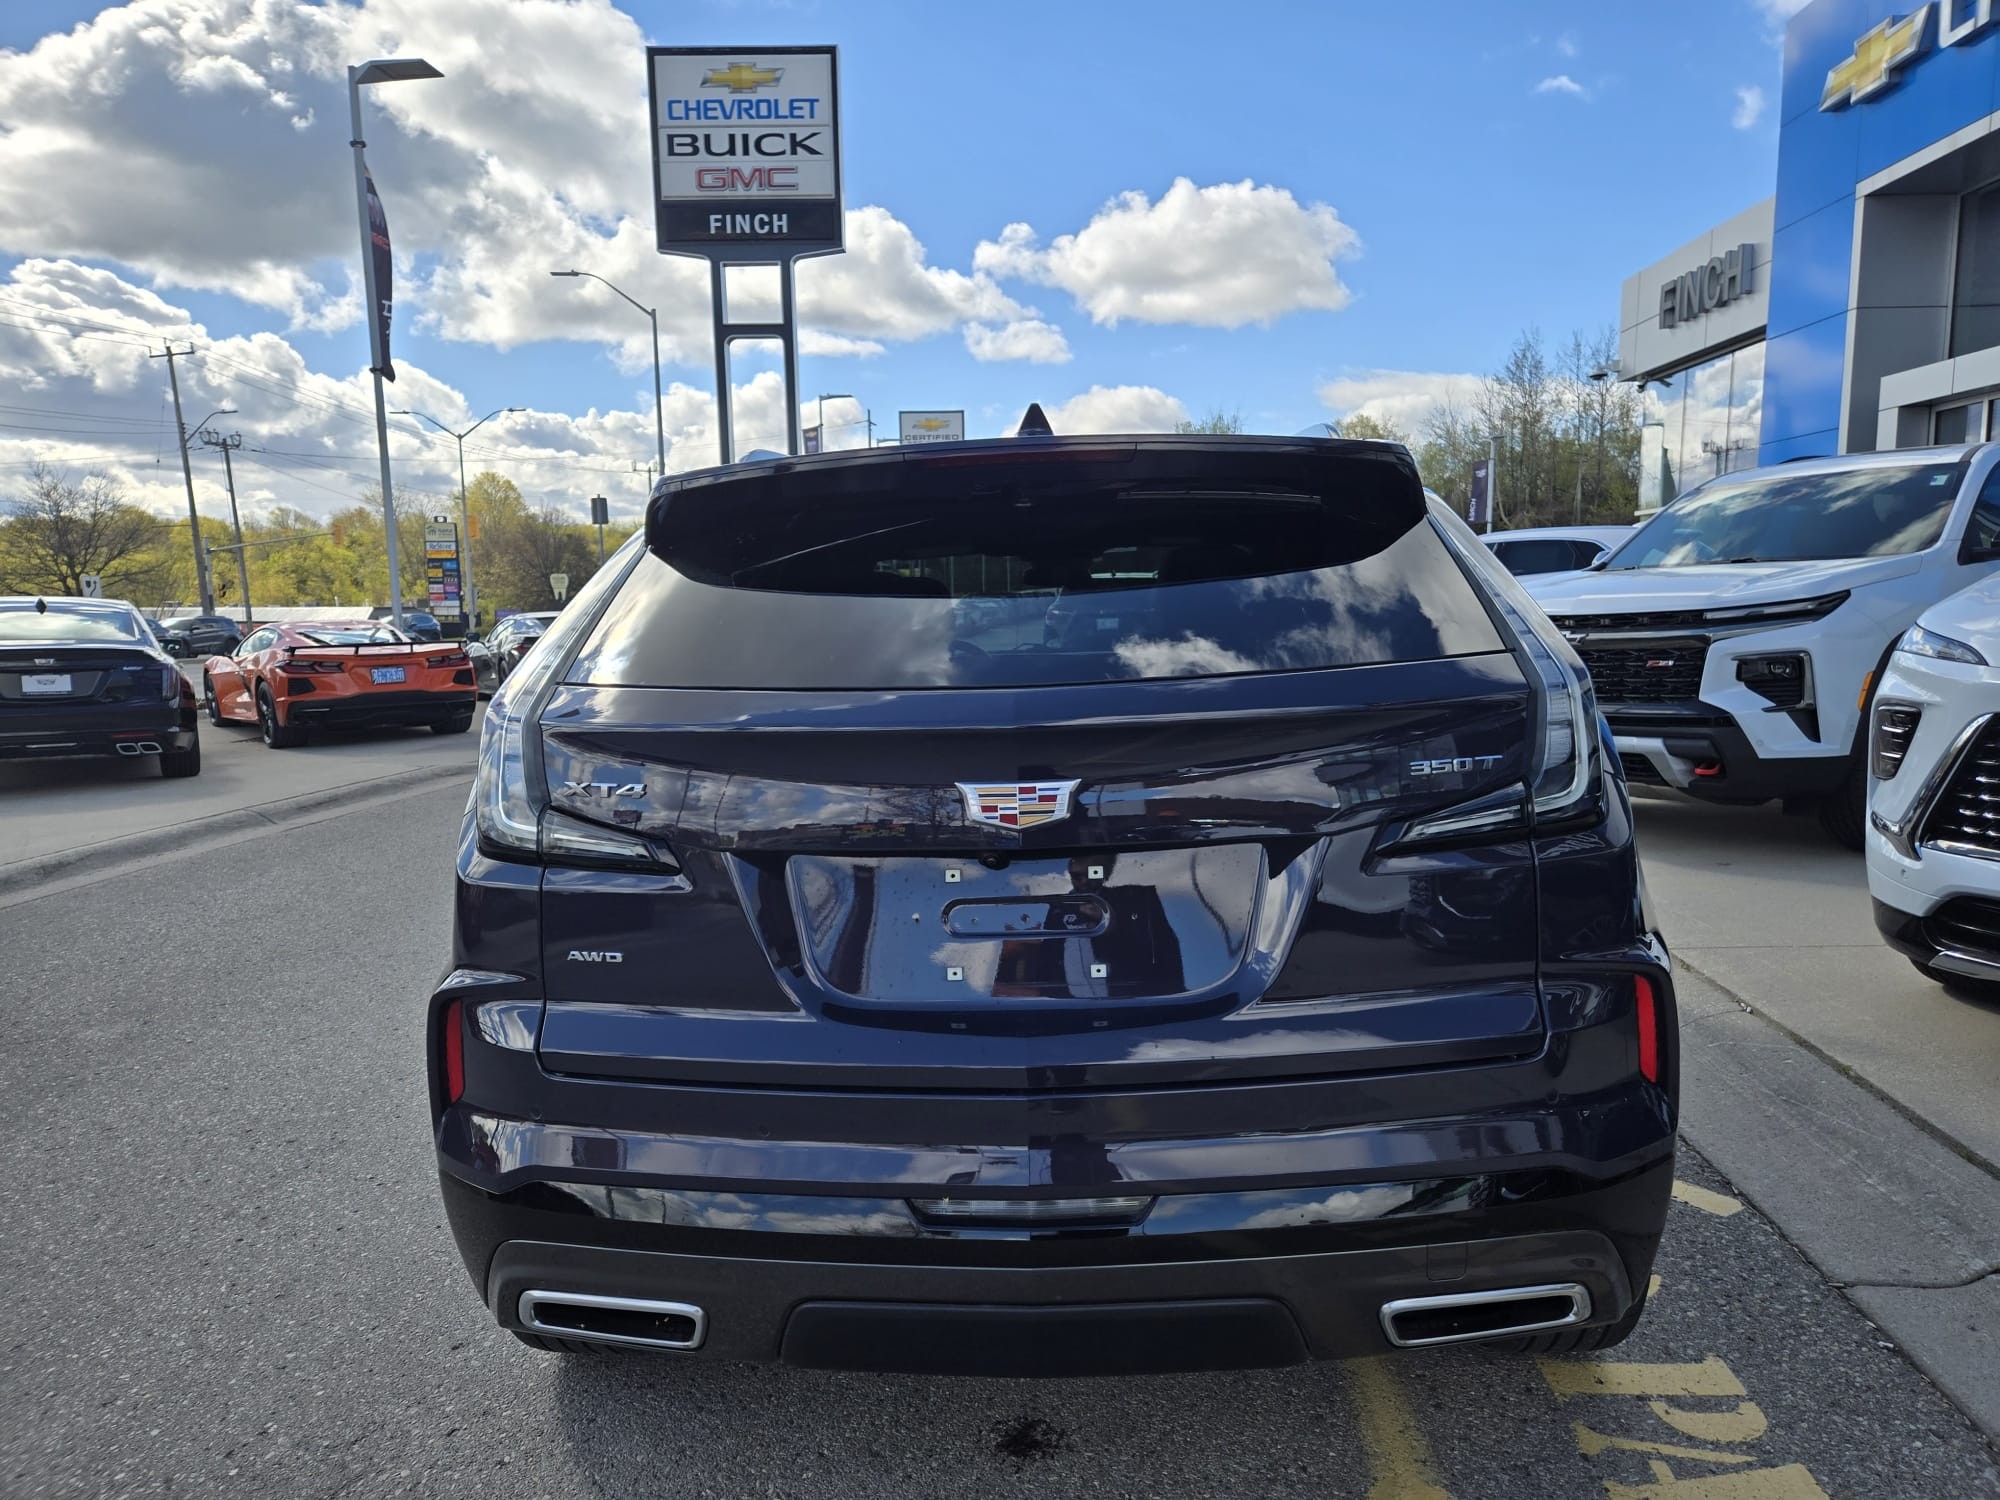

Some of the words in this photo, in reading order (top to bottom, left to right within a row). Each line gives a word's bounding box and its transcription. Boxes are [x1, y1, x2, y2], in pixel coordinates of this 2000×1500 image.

[667, 98, 820, 120] CHEVROLET
[666, 132, 823, 157] BUICK
[695, 166, 799, 191] GMC
[709, 213, 788, 234] FINCH
[1659, 243, 1754, 330] FINCH
[563, 781, 647, 799] XT4
[567, 950, 623, 963] AWD
